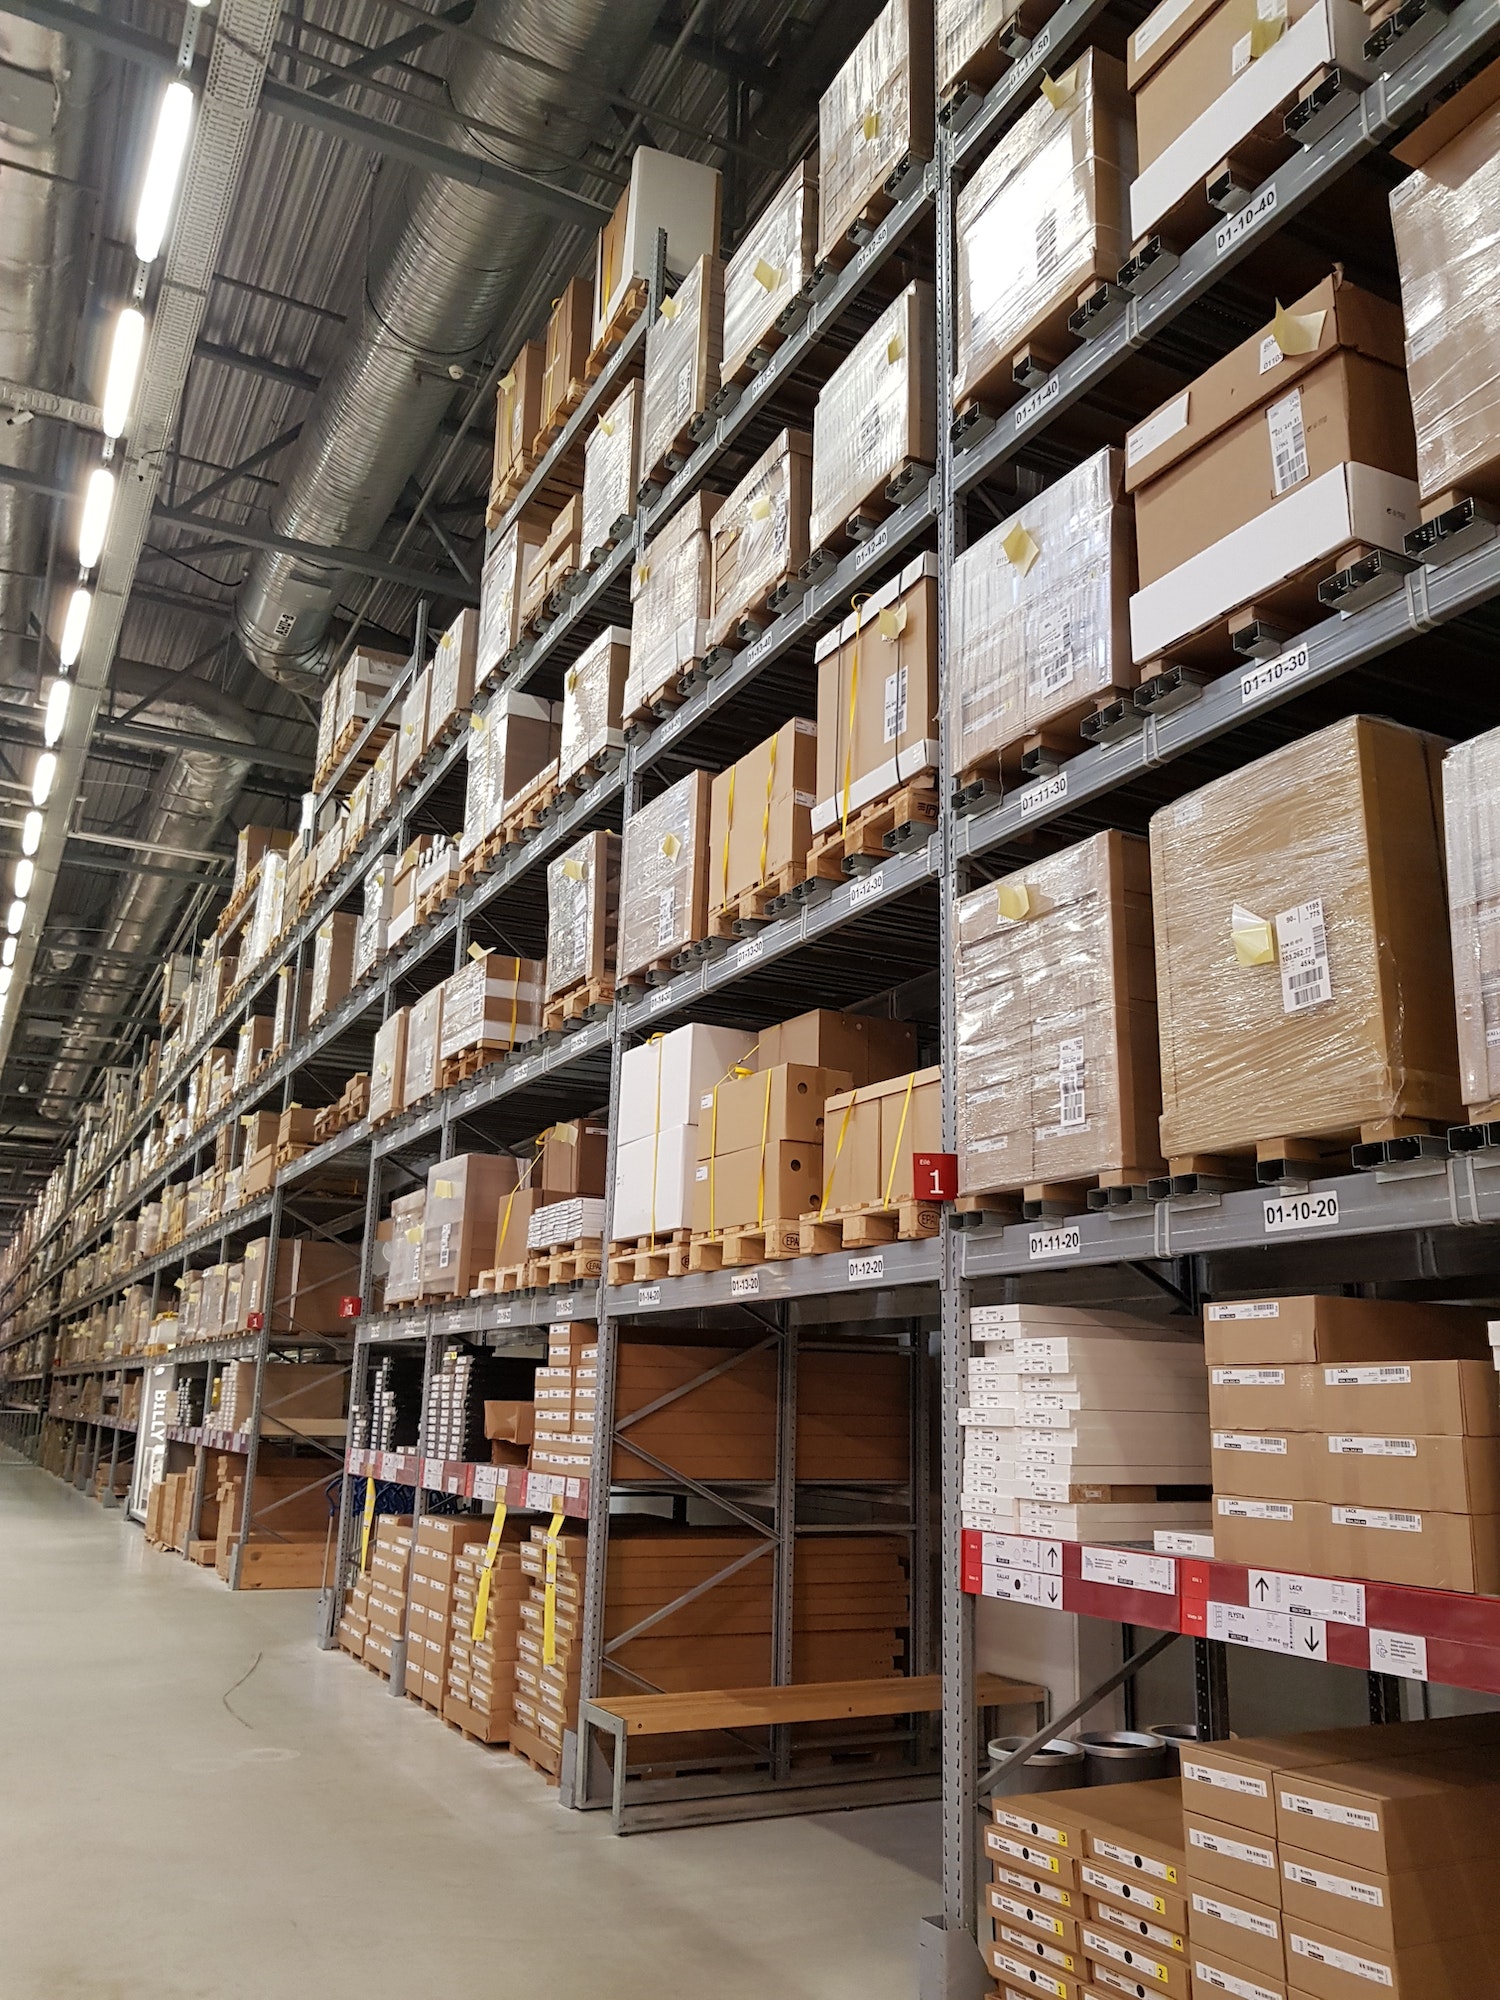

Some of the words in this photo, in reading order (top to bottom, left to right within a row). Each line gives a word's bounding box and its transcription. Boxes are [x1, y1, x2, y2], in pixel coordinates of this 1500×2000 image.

[1010, 34, 1049, 86] 01-11-50
[1217, 191, 1274, 250] 01-10-40
[856, 228, 888, 268] 01-12-50
[1016, 380, 1058, 424] 01-11-40
[856, 532, 886, 566] 01-12-40
[1243, 650, 1307, 696] 01-10-30
[1022, 778, 1066, 811] 01-11-30
[850, 876, 883, 901] 01-12-30
[738, 941, 763, 962] 01-13-30
[930, 1168, 944, 1194] 1
[1266, 1198, 1337, 1225] 01-10-20
[1030, 1232, 1079, 1253] 01-11-20
[849, 1260, 883, 1276] 01-12-20
[732, 1276, 759, 1292] 01-13-20
[150, 1390, 167, 1442] BILLY
[1288, 1584, 1303, 1592] LACK
[1228, 1611, 1245, 1620] FLYSTA
[1060, 1834, 1066, 1842] 3
[1050, 1860, 1055, 1870] 1
[1169, 1870, 1175, 1878] 4
[1155, 1900, 1162, 1910] 2
[1054, 1924, 1059, 1932] 1
[1175, 1938, 1182, 1946] 4
[1066, 1958, 1072, 1966] 3
[1158, 1968, 1164, 1978] 2
[1058, 1986, 1062, 1996] 1
